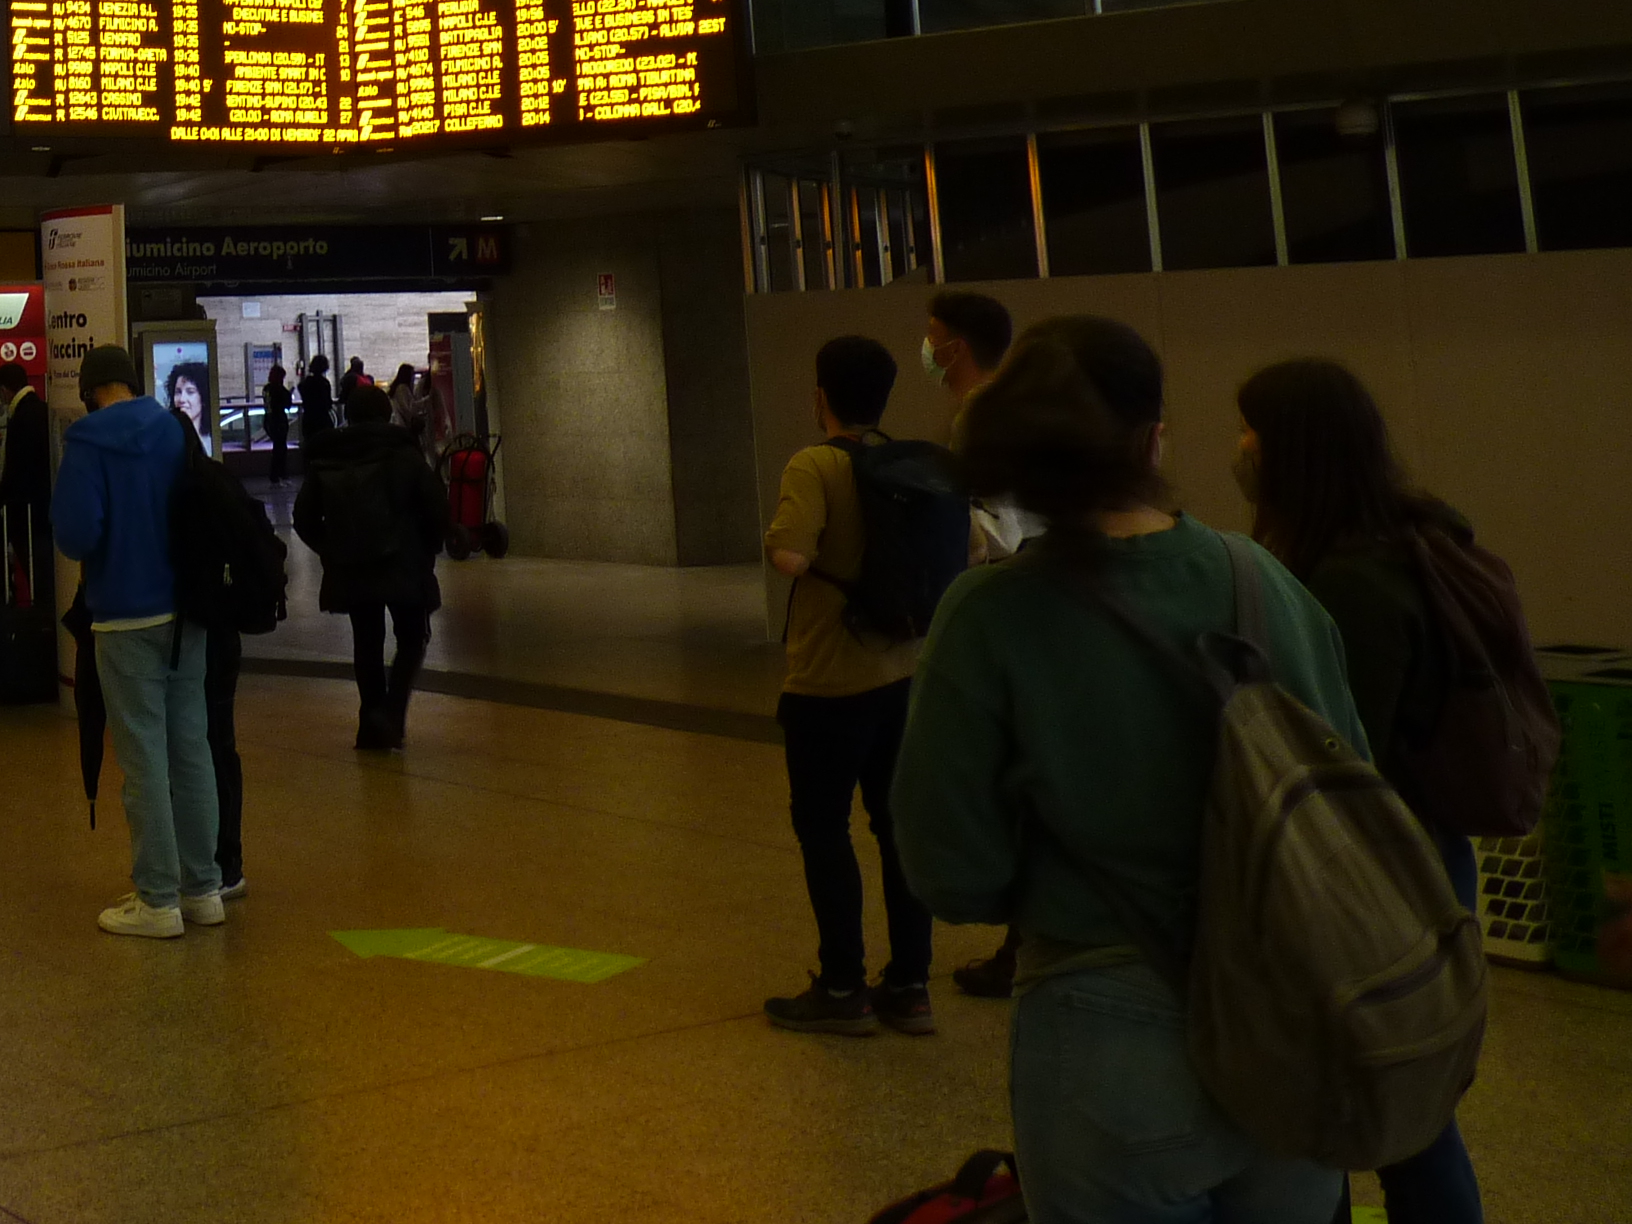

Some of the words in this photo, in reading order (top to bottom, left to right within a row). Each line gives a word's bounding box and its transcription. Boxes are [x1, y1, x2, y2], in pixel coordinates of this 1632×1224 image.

[125, 236, 216, 257] iumicino
[221, 235, 329, 260] Aeroporto
[477, 237, 499, 256] M
[125, 263, 170, 277] umicino
[174, 262, 217, 279] Airport
